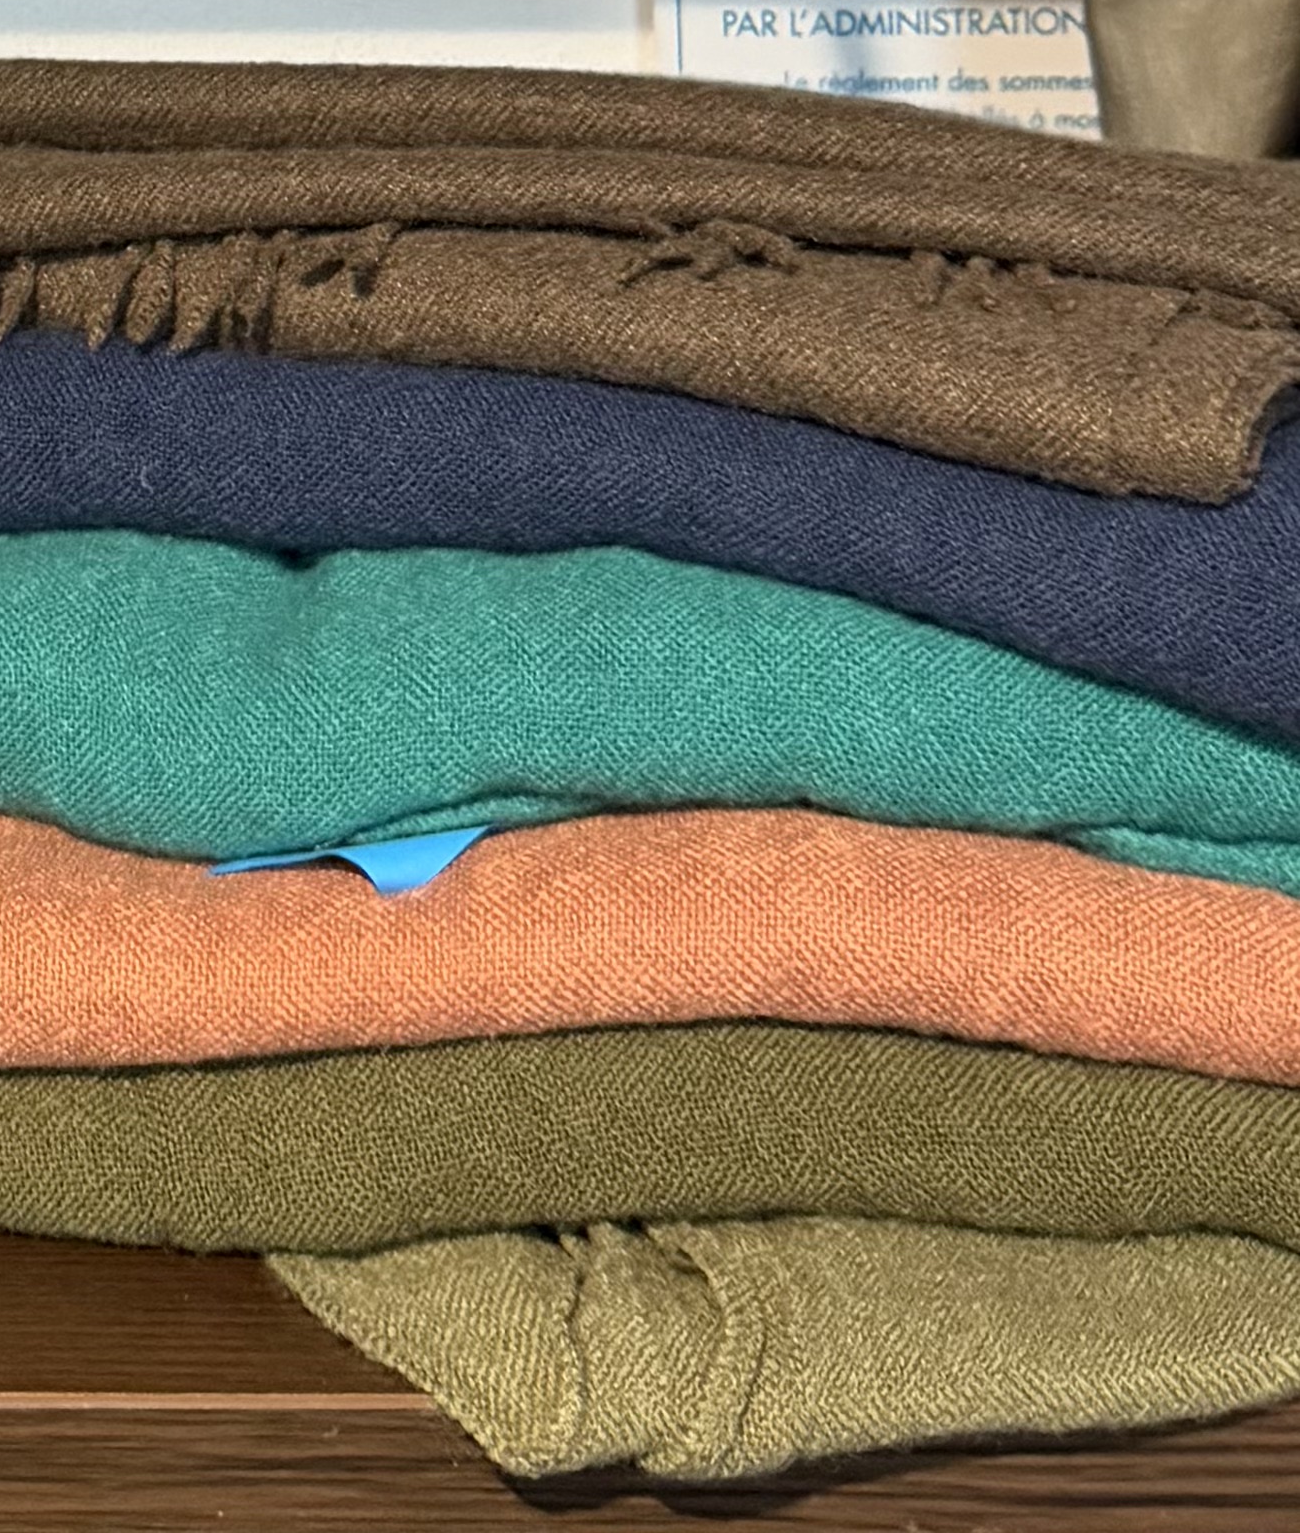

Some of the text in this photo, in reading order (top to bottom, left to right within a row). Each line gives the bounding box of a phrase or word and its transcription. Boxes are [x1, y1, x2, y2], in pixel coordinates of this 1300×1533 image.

[722, 7, 1087, 37] PAR L'ADMINISTRATION
[948, 67, 988, 91] des
